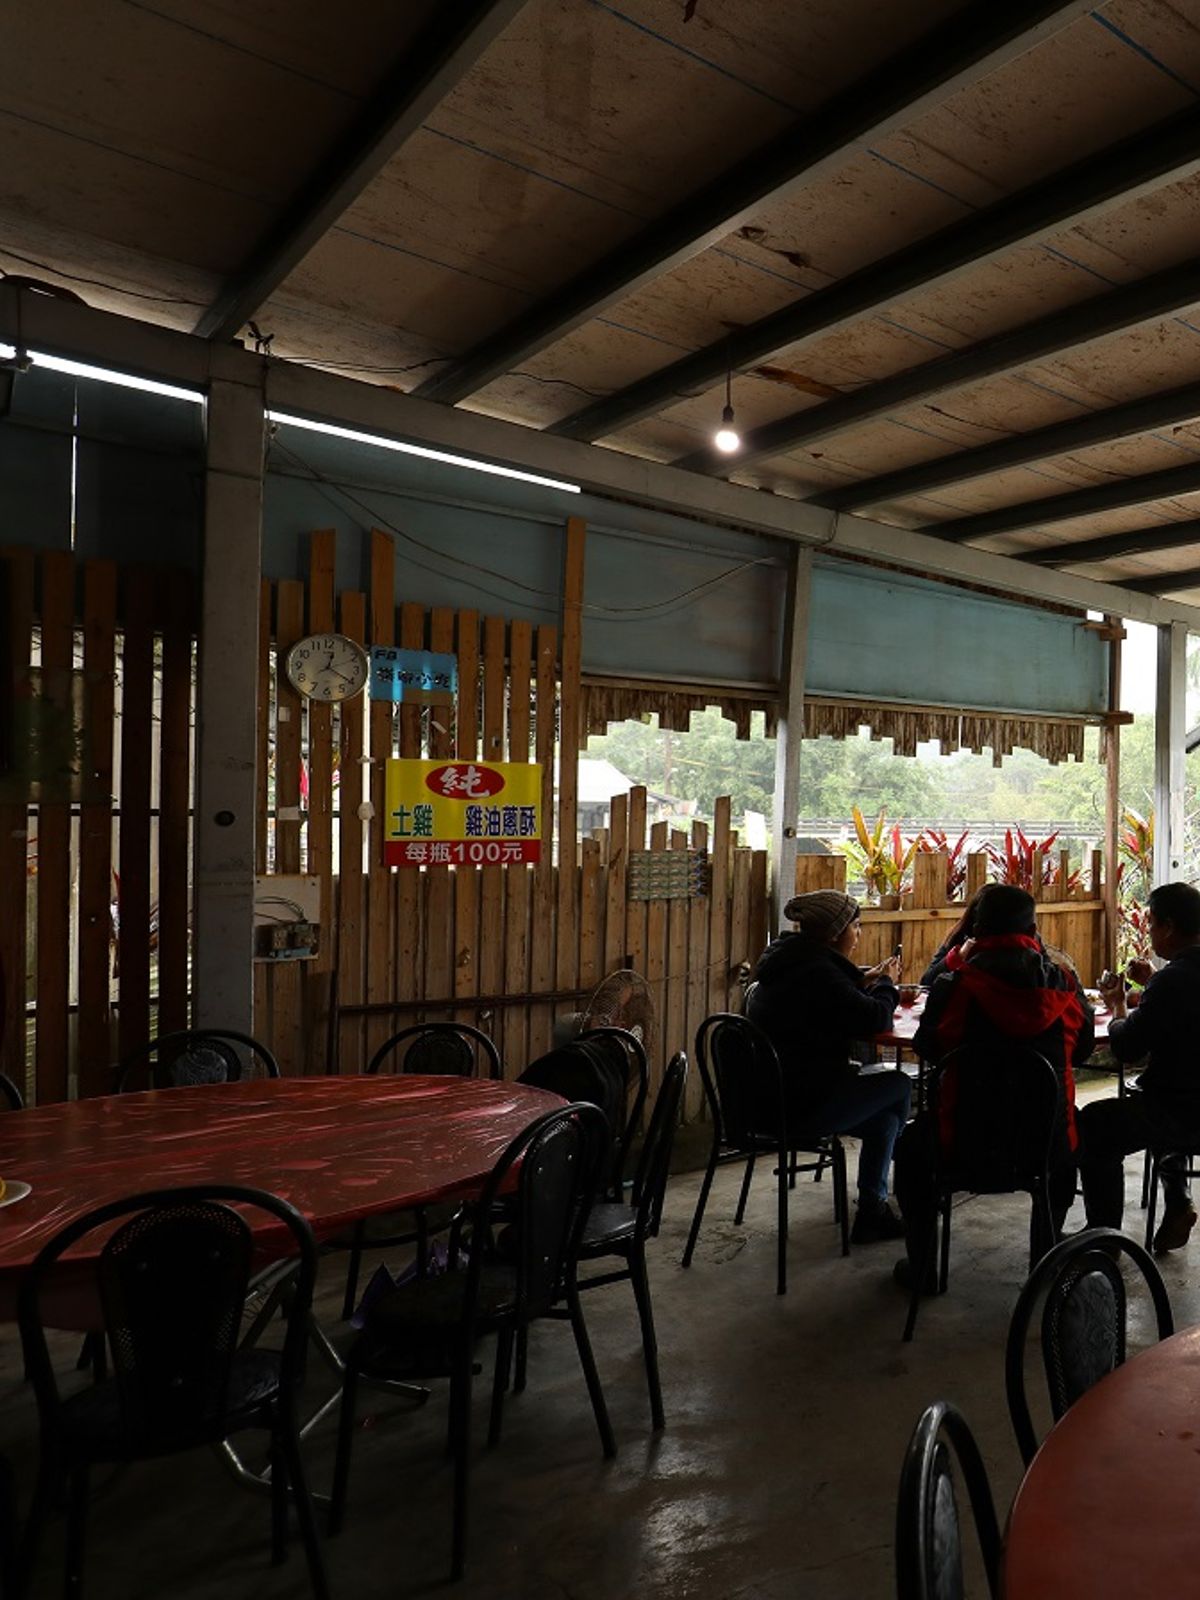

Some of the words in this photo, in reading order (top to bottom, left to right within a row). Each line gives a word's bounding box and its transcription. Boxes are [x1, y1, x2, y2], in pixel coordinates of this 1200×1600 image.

[440, 765, 490, 798] 純
[391, 804, 433, 837] 土雞
[405, 842, 523, 864] 每瓶100元
